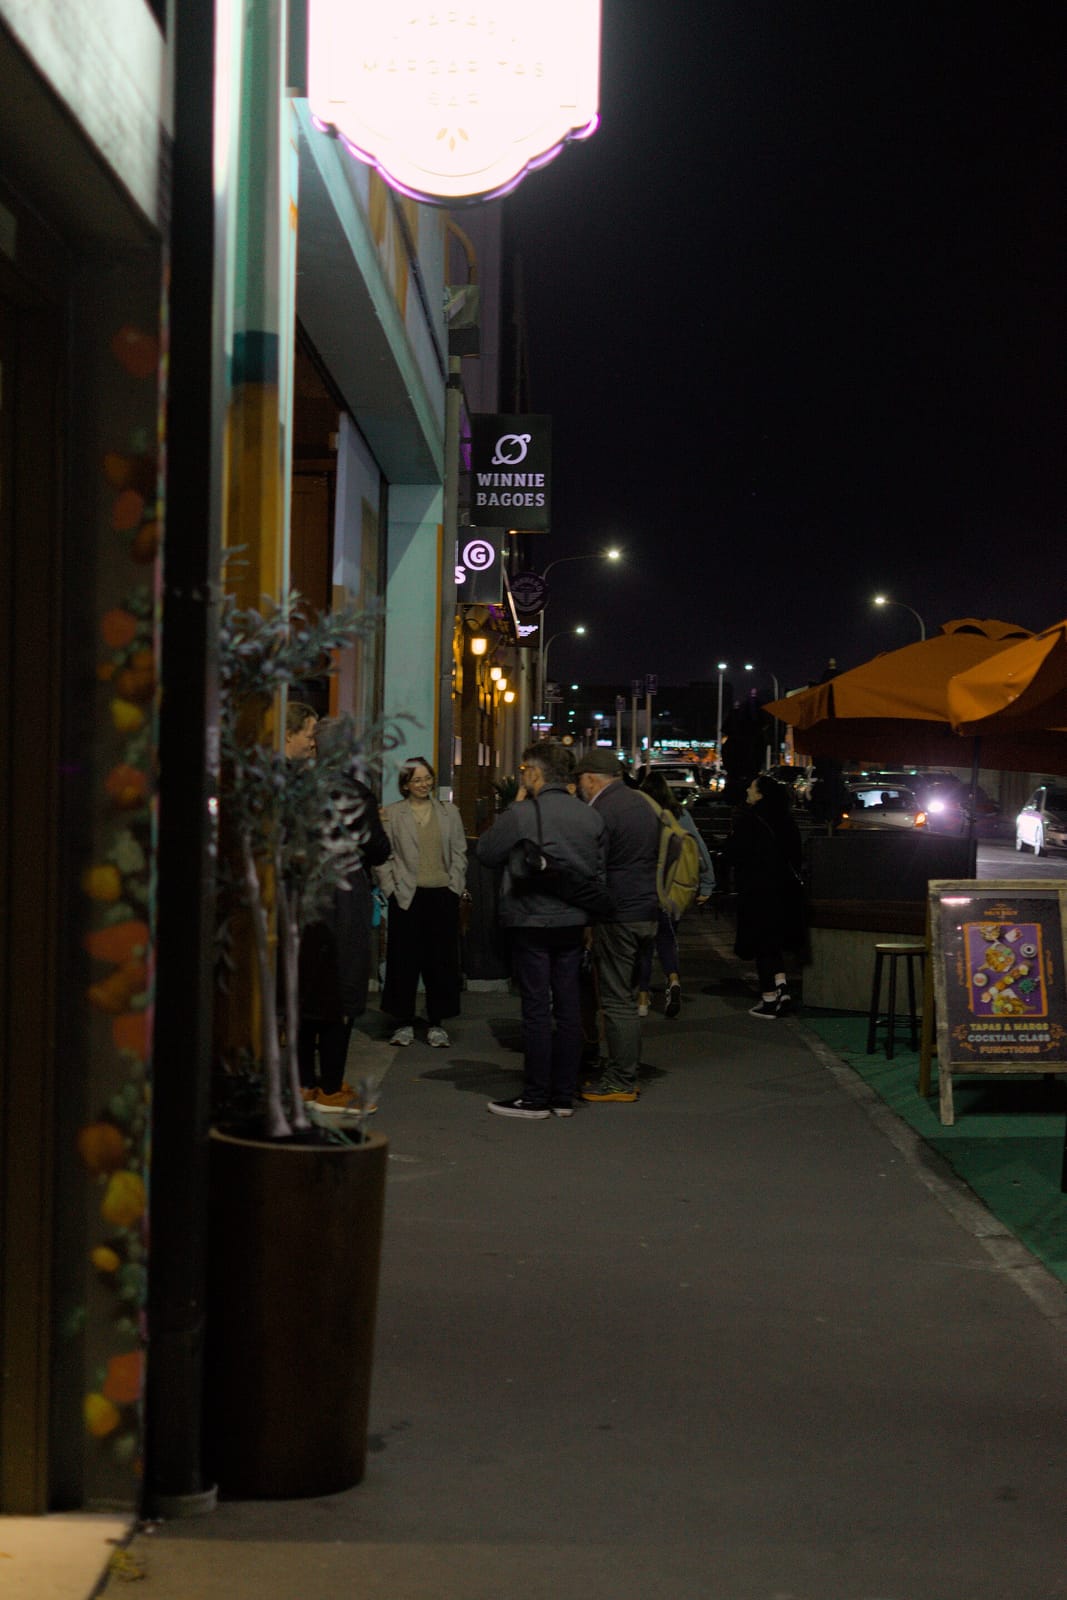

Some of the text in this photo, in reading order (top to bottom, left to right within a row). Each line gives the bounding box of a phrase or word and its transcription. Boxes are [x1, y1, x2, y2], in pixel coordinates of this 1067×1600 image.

[476, 473, 545, 487] WINNIE
[476, 493, 545, 507] BAGOES
[970, 1023, 1001, 1031] TAPAS
[968, 1034, 1051, 1042] COCKTAIL CLASS
